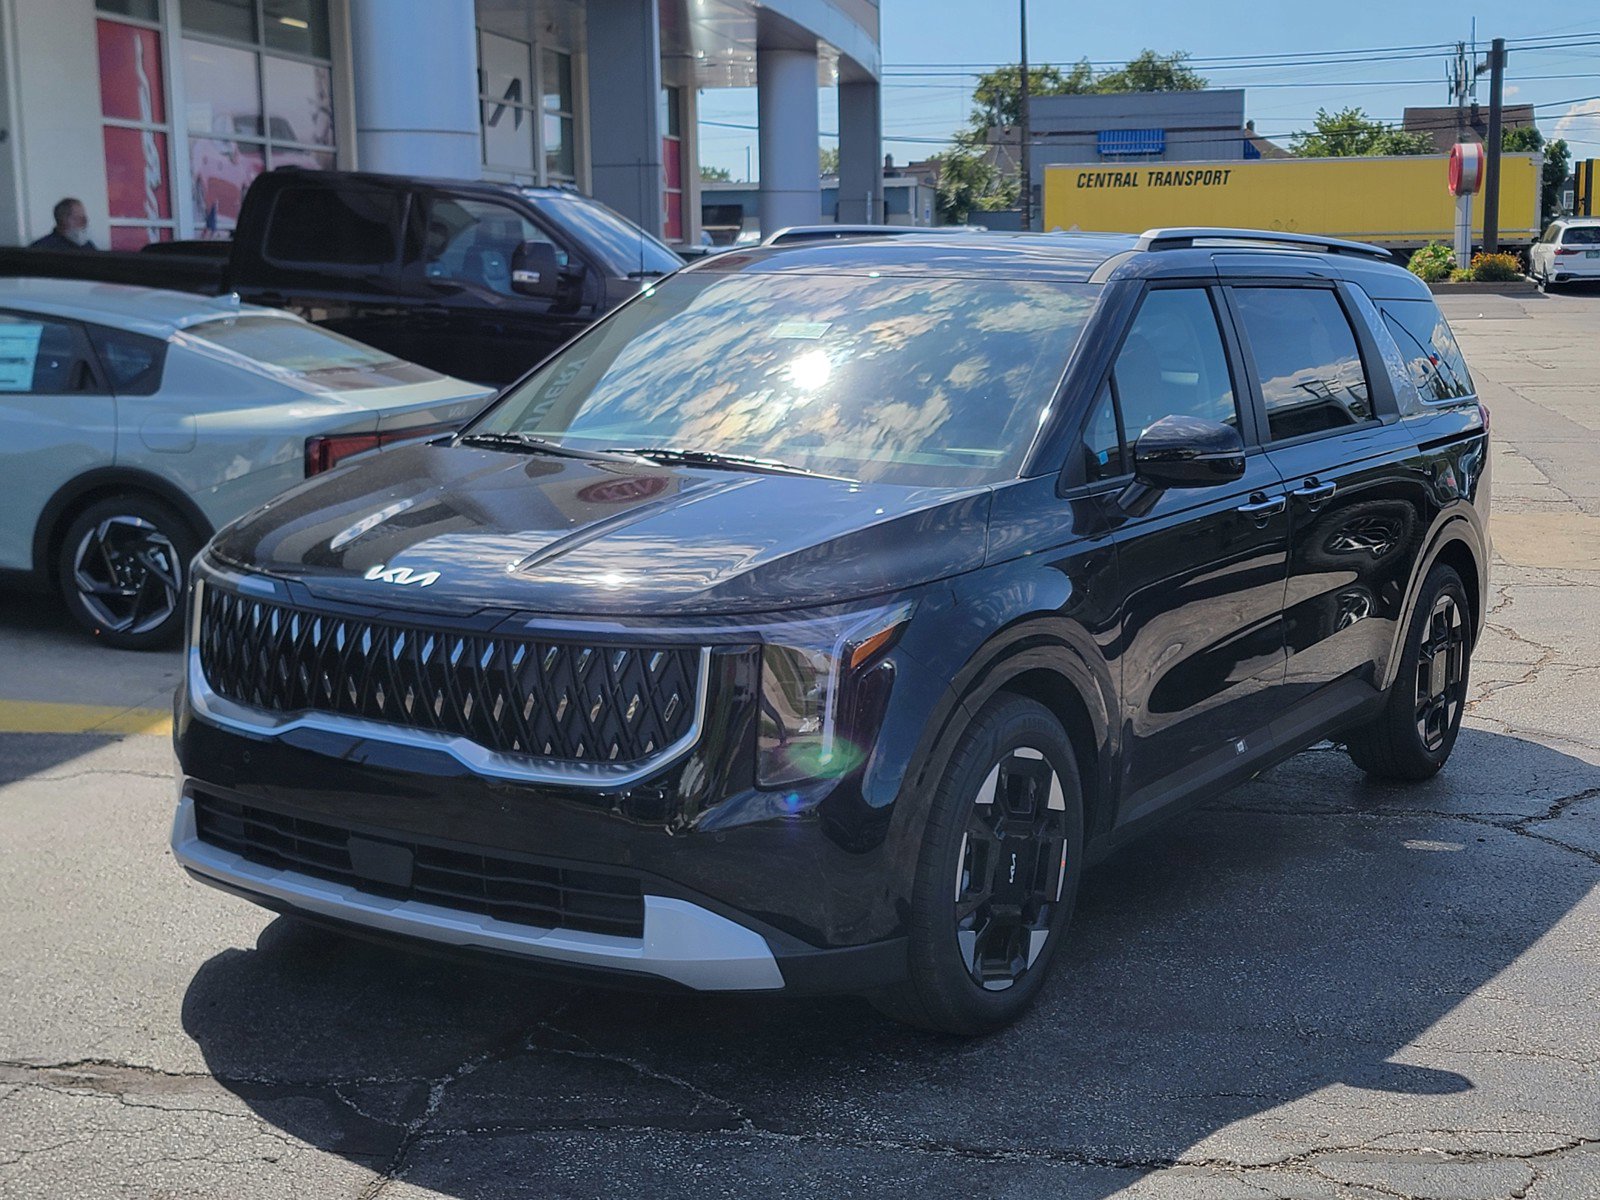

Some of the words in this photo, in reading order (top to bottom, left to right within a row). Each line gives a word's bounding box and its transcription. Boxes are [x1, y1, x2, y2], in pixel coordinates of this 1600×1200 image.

[1076, 171, 1139, 189] CENTRAL
[1147, 169, 1232, 187] TRANSPORT
[364, 564, 442, 588] KIA
